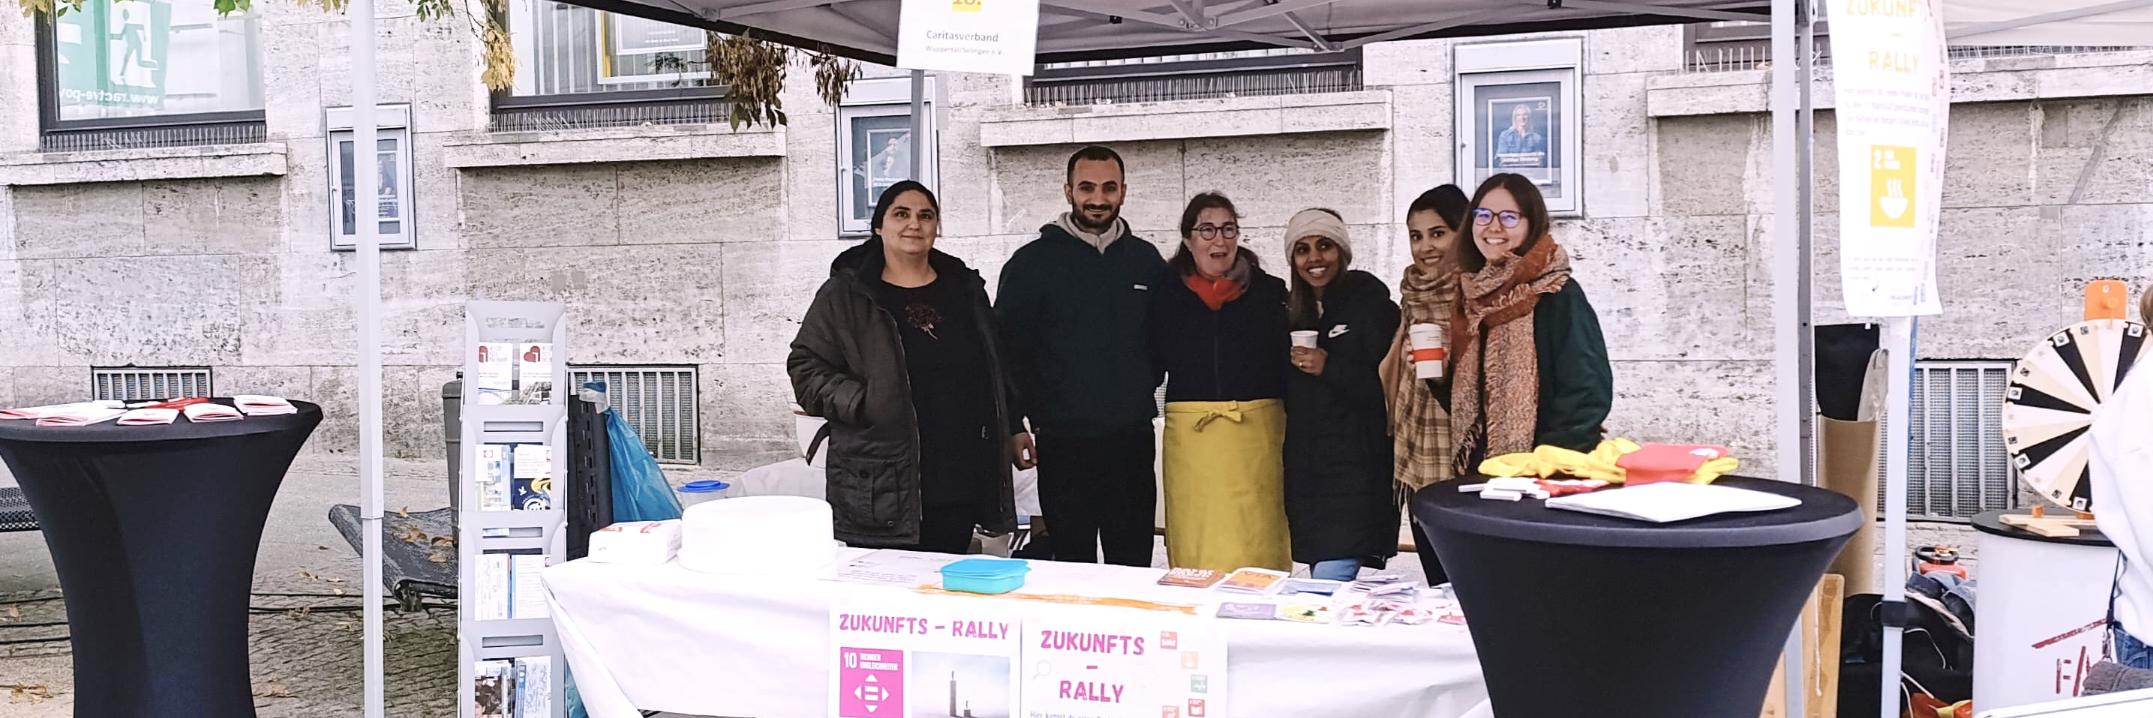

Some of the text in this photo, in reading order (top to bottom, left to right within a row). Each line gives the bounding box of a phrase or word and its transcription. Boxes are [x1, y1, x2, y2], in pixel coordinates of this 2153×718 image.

[926, 30, 999, 42] Caritasverband
[1868, 50, 1919, 73] RALLY
[839, 614, 928, 634] ZUKUNFTS
[952, 620, 1008, 640] RALLY
[1041, 630, 1145, 655] ZUKUNFTS
[844, 652, 858, 669] 10
[1059, 680, 1124, 703] RALLY
